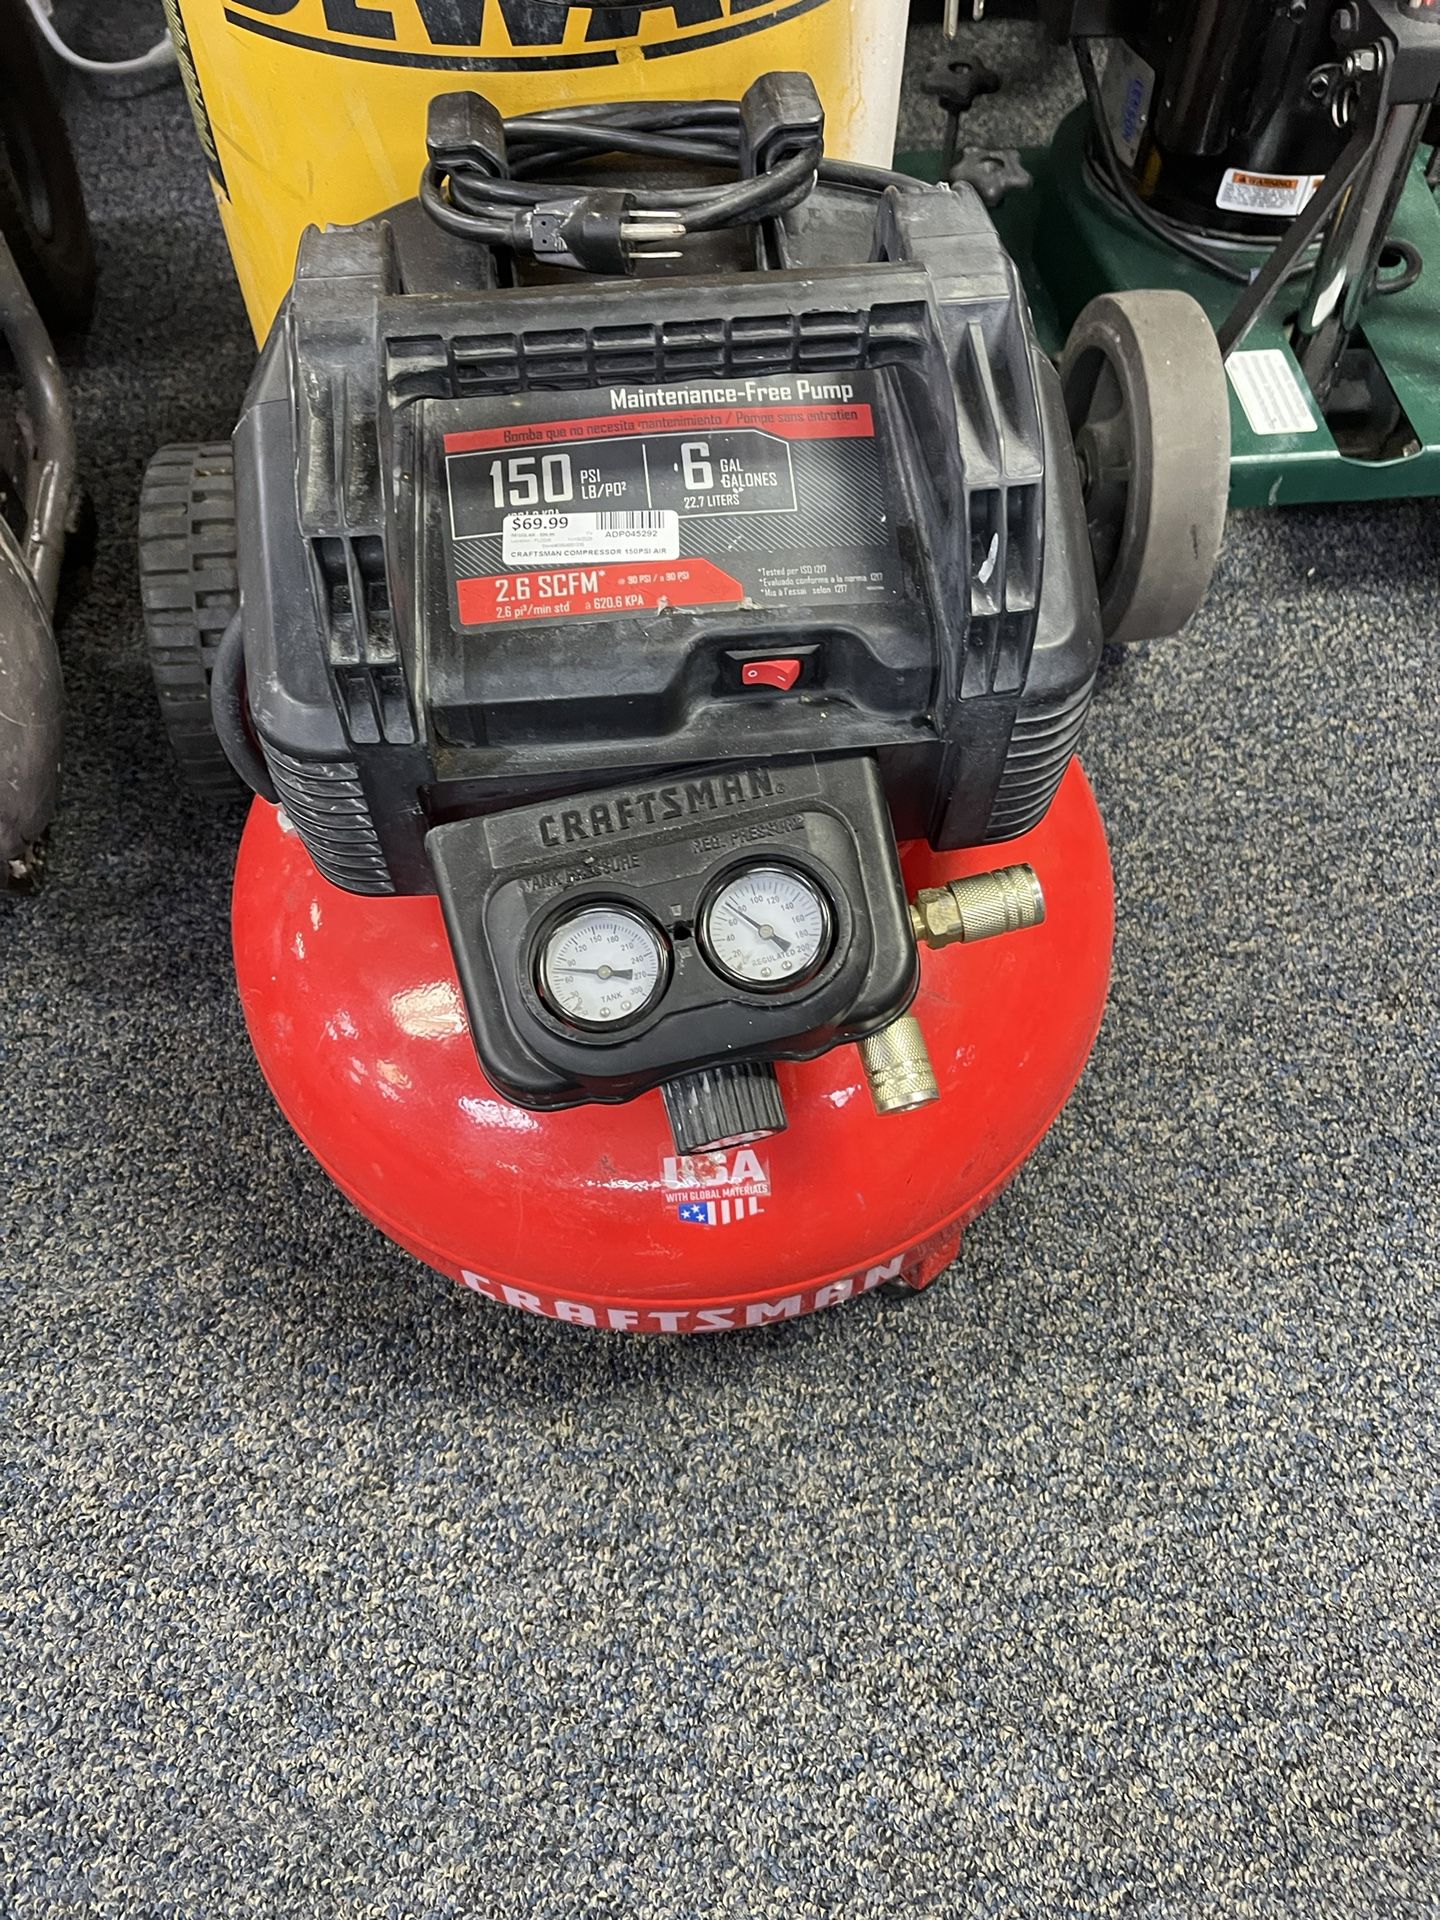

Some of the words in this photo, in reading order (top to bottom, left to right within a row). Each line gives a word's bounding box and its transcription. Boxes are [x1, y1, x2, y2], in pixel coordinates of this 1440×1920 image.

[610, 381, 791, 410] Maintenance-Free
[797, 380, 854, 402] Pump
[503, 430, 543, 443] Bomba
[546, 428, 567, 440] que
[570, 427, 584, 436] no
[587, 421, 635, 434] necesita
[639, 414, 721, 430] mantenimiento
[736, 411, 774, 424] Pompe
[778, 412, 804, 422] sans
[807, 409, 858, 421] entretien
[680, 442, 714, 490] 6
[720, 458, 744, 472] GAL
[489, 453, 574, 508] 150
[580, 469, 601, 484] PSI
[721, 472, 778, 488] GALONES
[684, 495, 705, 509] 22.7
[707, 493, 740, 507] LITERS
[512, 516, 569, 531] $69.99
[605, 530, 658, 538] ADP045292
[563, 549, 622, 557] COMPRESSOR
[787, 568, 799, 576] per
[800, 565, 812, 574] ISO
[814, 564, 827, 574] 1217
[627, 575, 638, 584] 90
[639, 574, 651, 583] PSI
[677, 571, 689, 580] PSI
[870, 572, 883, 581] 1217
[495, 575, 530, 602] 2.6
[812, 585, 831, 594] selon
[834, 584, 847, 593] 1217
[495, 605, 511, 618] 2.6
[514, 603, 551, 619] pi³/min
[554, 601, 570, 613] std
[594, 596, 622, 609] 620.6
[625, 594, 644, 607] KPA
[731, 813, 805, 845] PRESSURE
[750, 895, 763, 904] 100
[766, 895, 779, 905] 120
[780, 902, 794, 911] 140
[728, 919, 738, 927] 60
[791, 915, 805, 923] 160
[606, 935, 619, 943] 180
[726, 934, 735, 942] 40
[795, 930, 809, 938] 180
[589, 935, 602, 944] 150
[574, 944, 587, 953] 120
[620, 942, 634, 951] 210
[797, 943, 810, 953] 200
[732, 949, 742, 958] 20
[752, 950, 796, 967] REGULATED
[631, 955, 644, 965] 240
[565, 976, 574, 984] 60
[633, 971, 647, 979] 270
[630, 986, 643, 995] 300
[600, 991, 623, 1003] TANK
[665, 1192, 688, 1203] WITH
[690, 1189, 721, 1201] GLOBAL
[722, 1184, 768, 1197] MATERIALS
[460, 1254, 905, 1332] CRAFTSMAN
